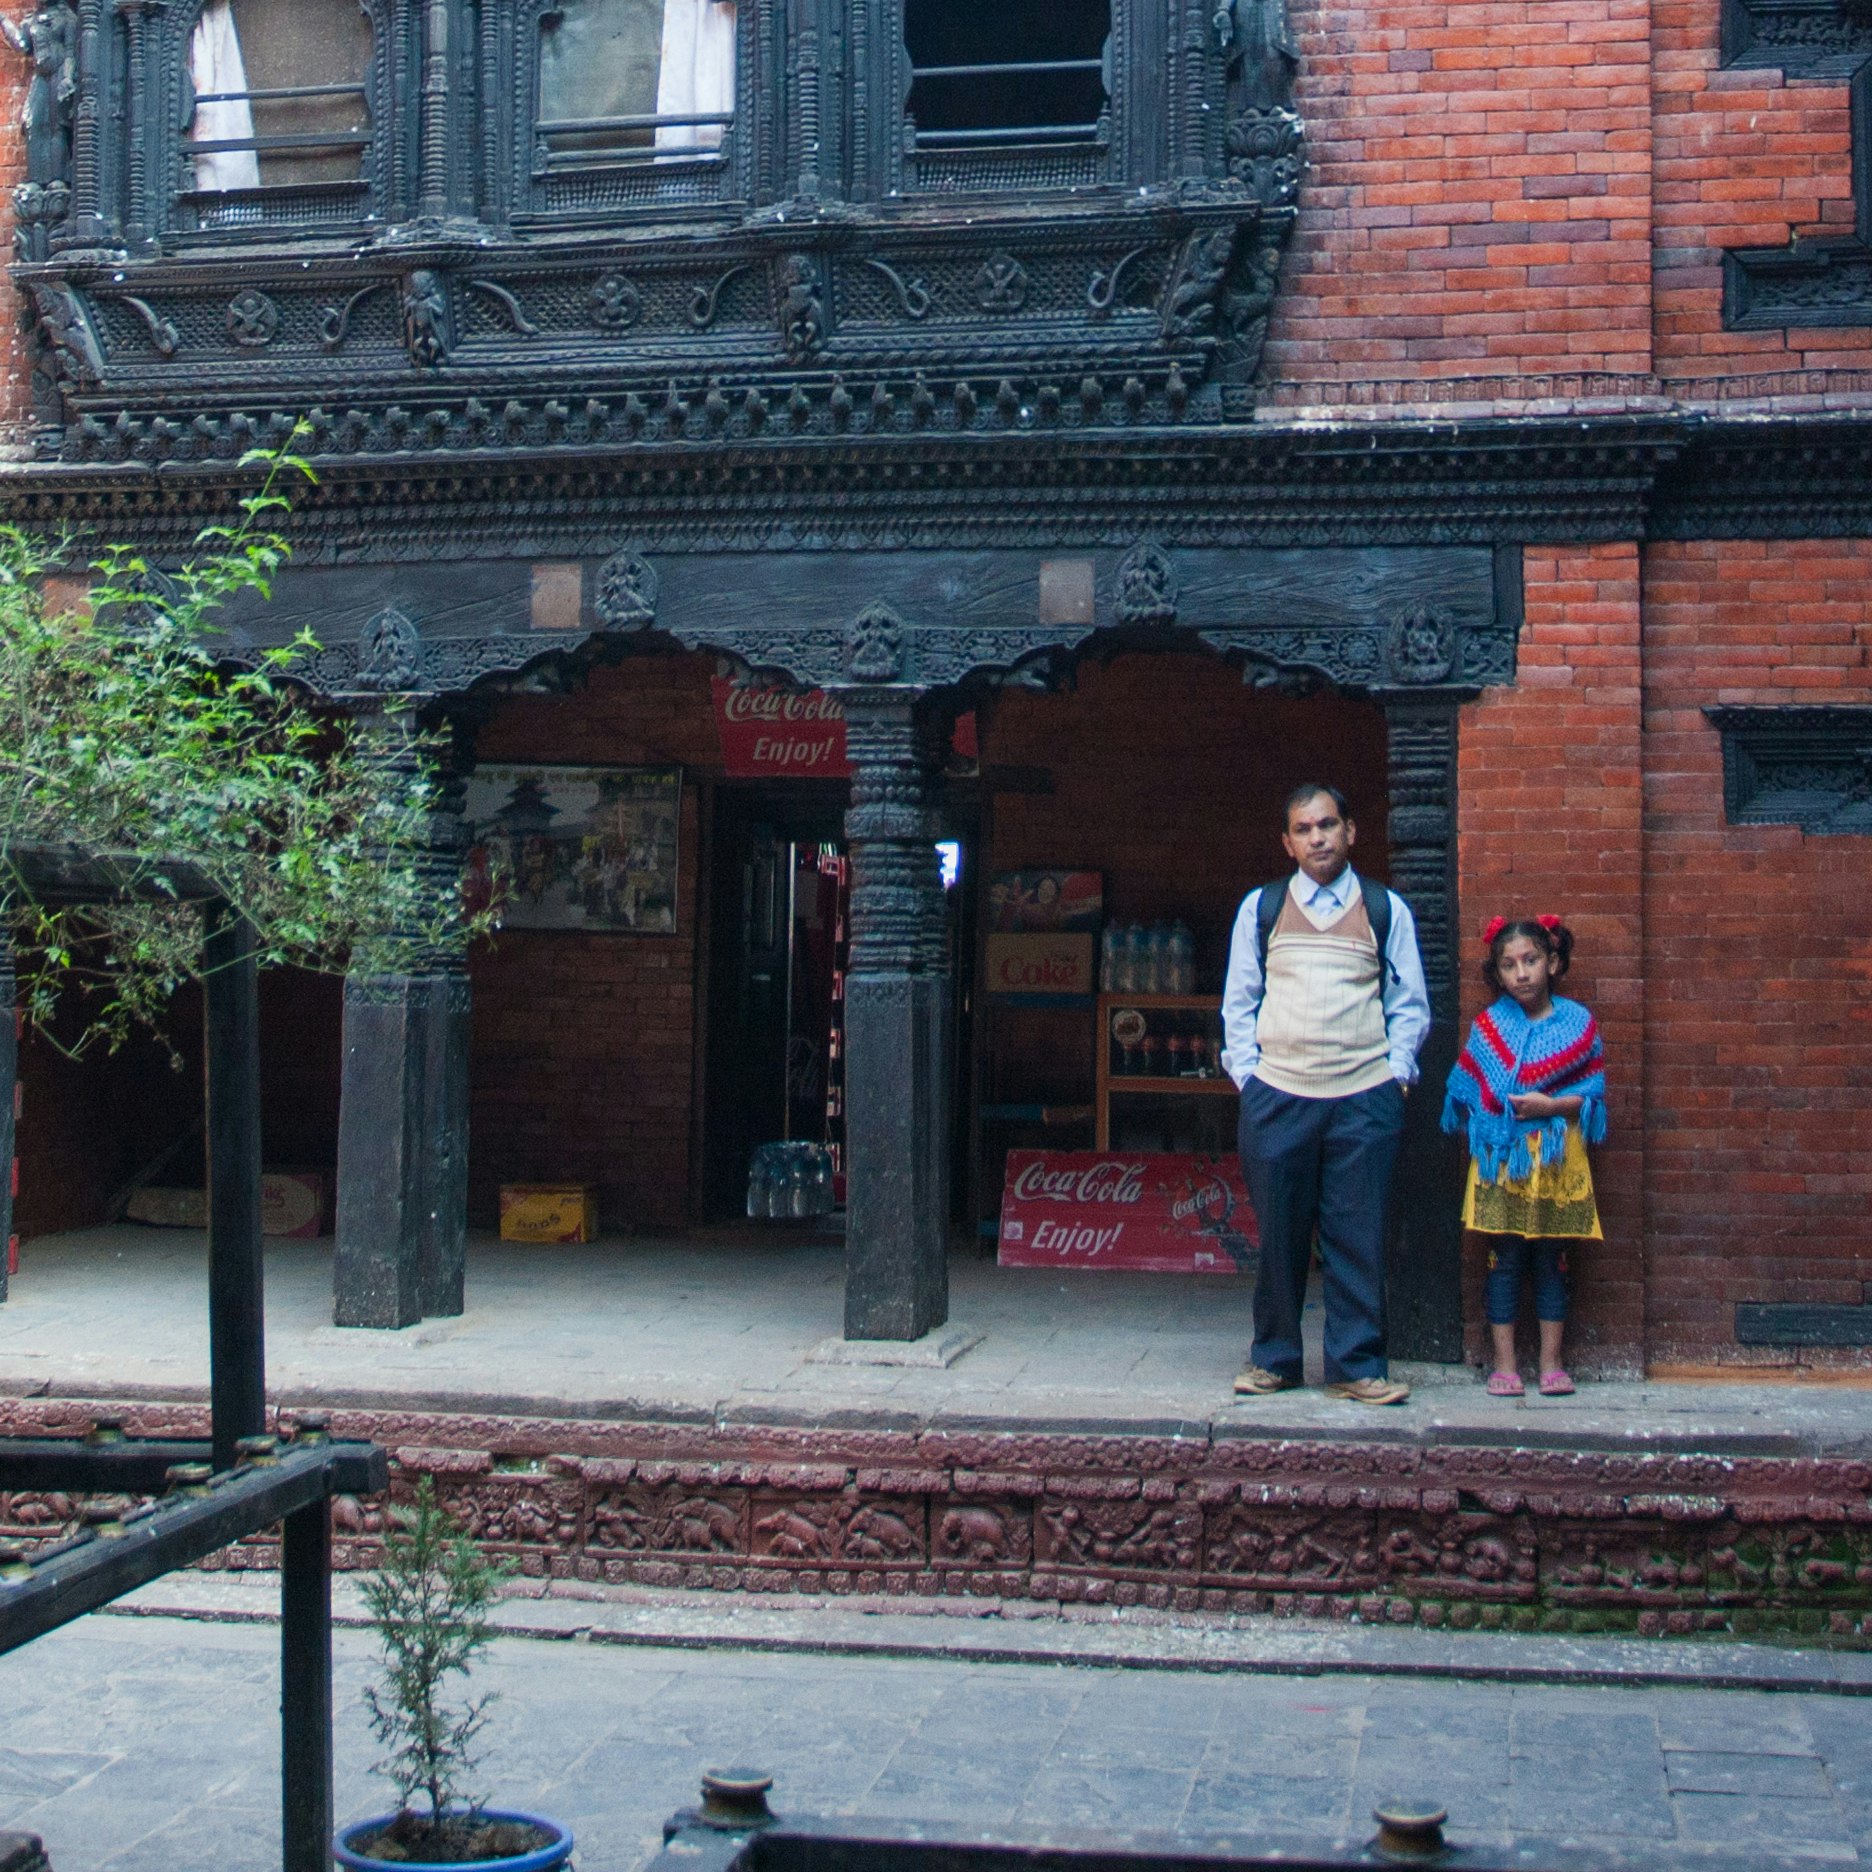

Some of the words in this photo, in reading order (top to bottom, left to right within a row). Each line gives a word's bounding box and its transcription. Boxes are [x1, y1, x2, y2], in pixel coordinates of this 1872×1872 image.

[753, 737, 836, 766] Enjoy!
[1000, 955, 1078, 986] Coke
[1014, 1161, 1149, 1203] Coca-Cola
[1031, 1220, 1125, 1257] Enjoy!
